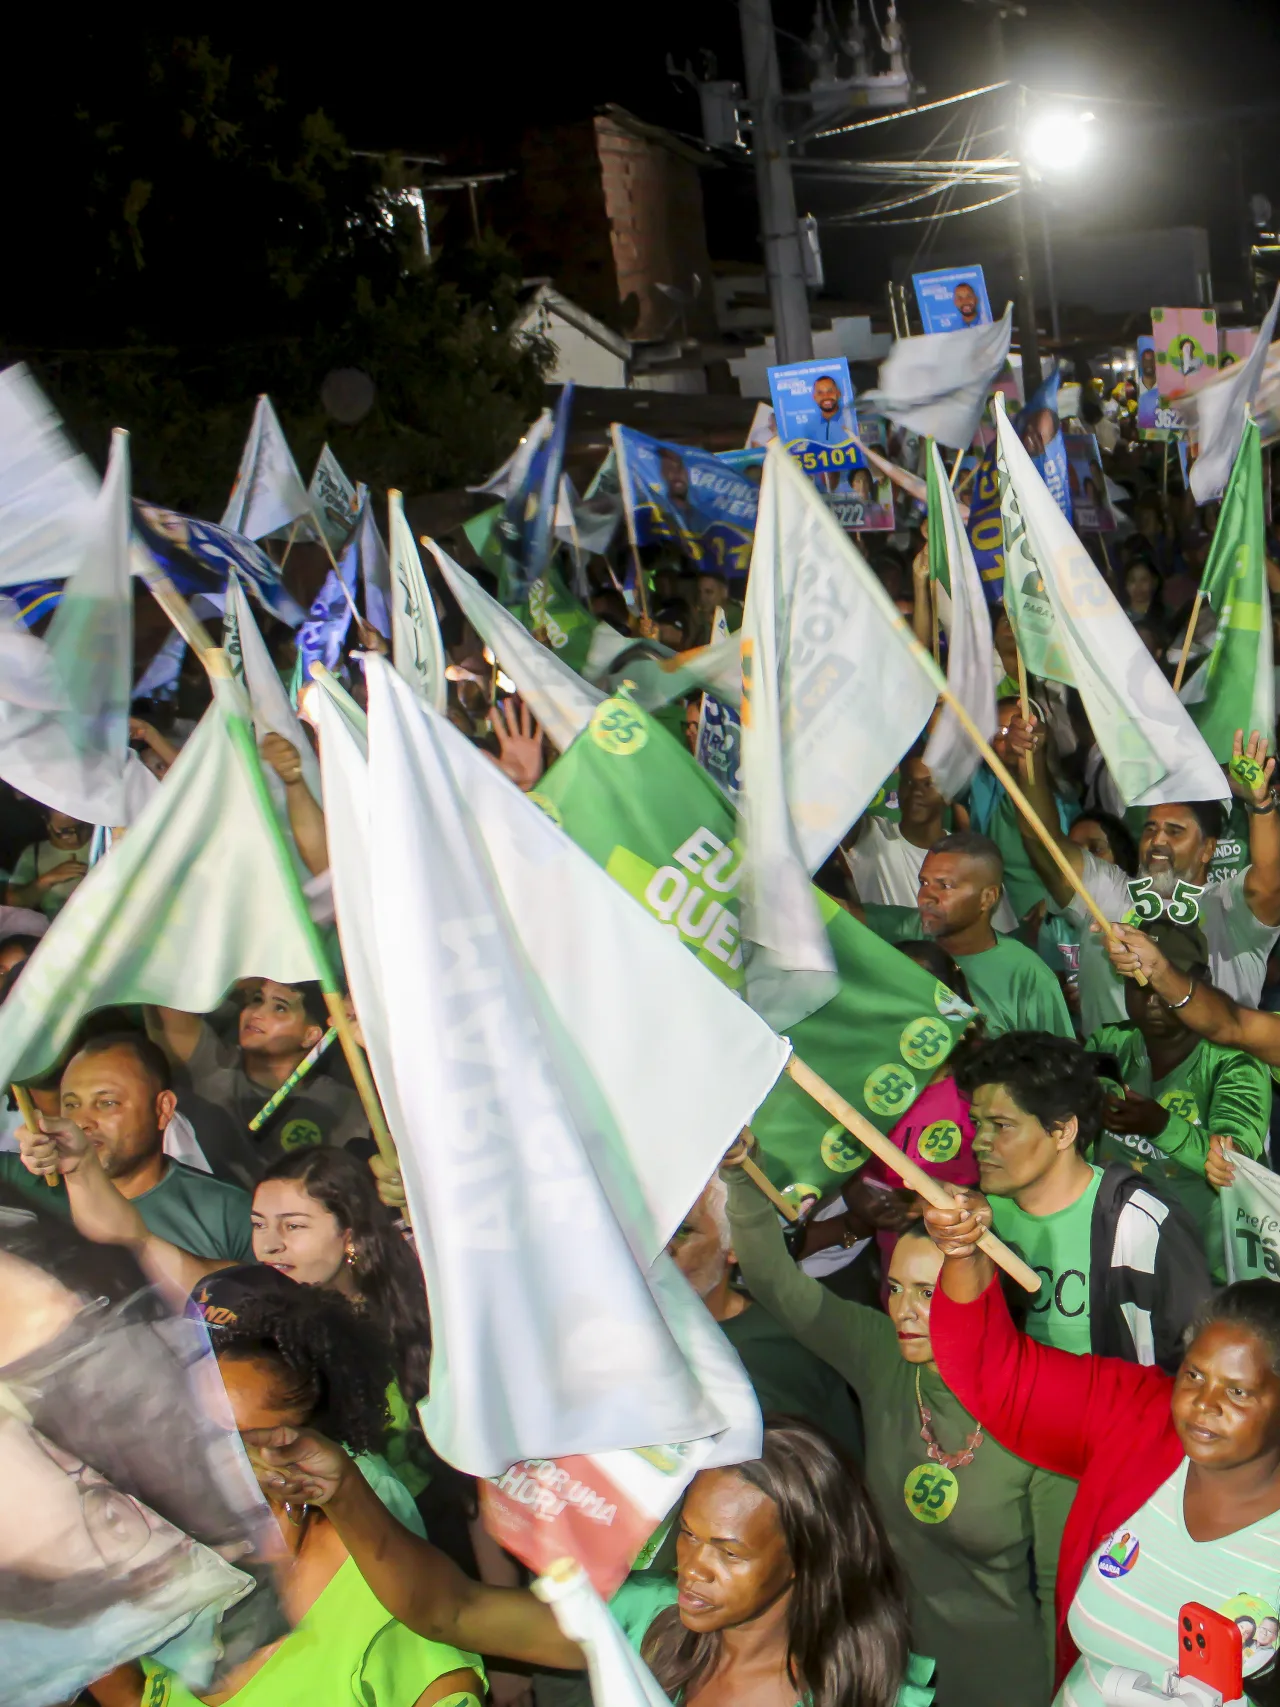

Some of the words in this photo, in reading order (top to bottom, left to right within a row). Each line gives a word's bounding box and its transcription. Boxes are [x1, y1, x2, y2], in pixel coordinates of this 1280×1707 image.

[601, 709, 644, 744] 55
[1232, 759, 1261, 782] 55
[672, 824, 743, 894] EU
[1126, 876, 1206, 925] 55
[908, 1025, 950, 1059] 55
[871, 1071, 915, 1105] 55
[1167, 1098, 1196, 1120] 55
[924, 1127, 957, 1151] 55
[566, 1480, 618, 1527] UMA
[911, 1473, 954, 1510] 55
